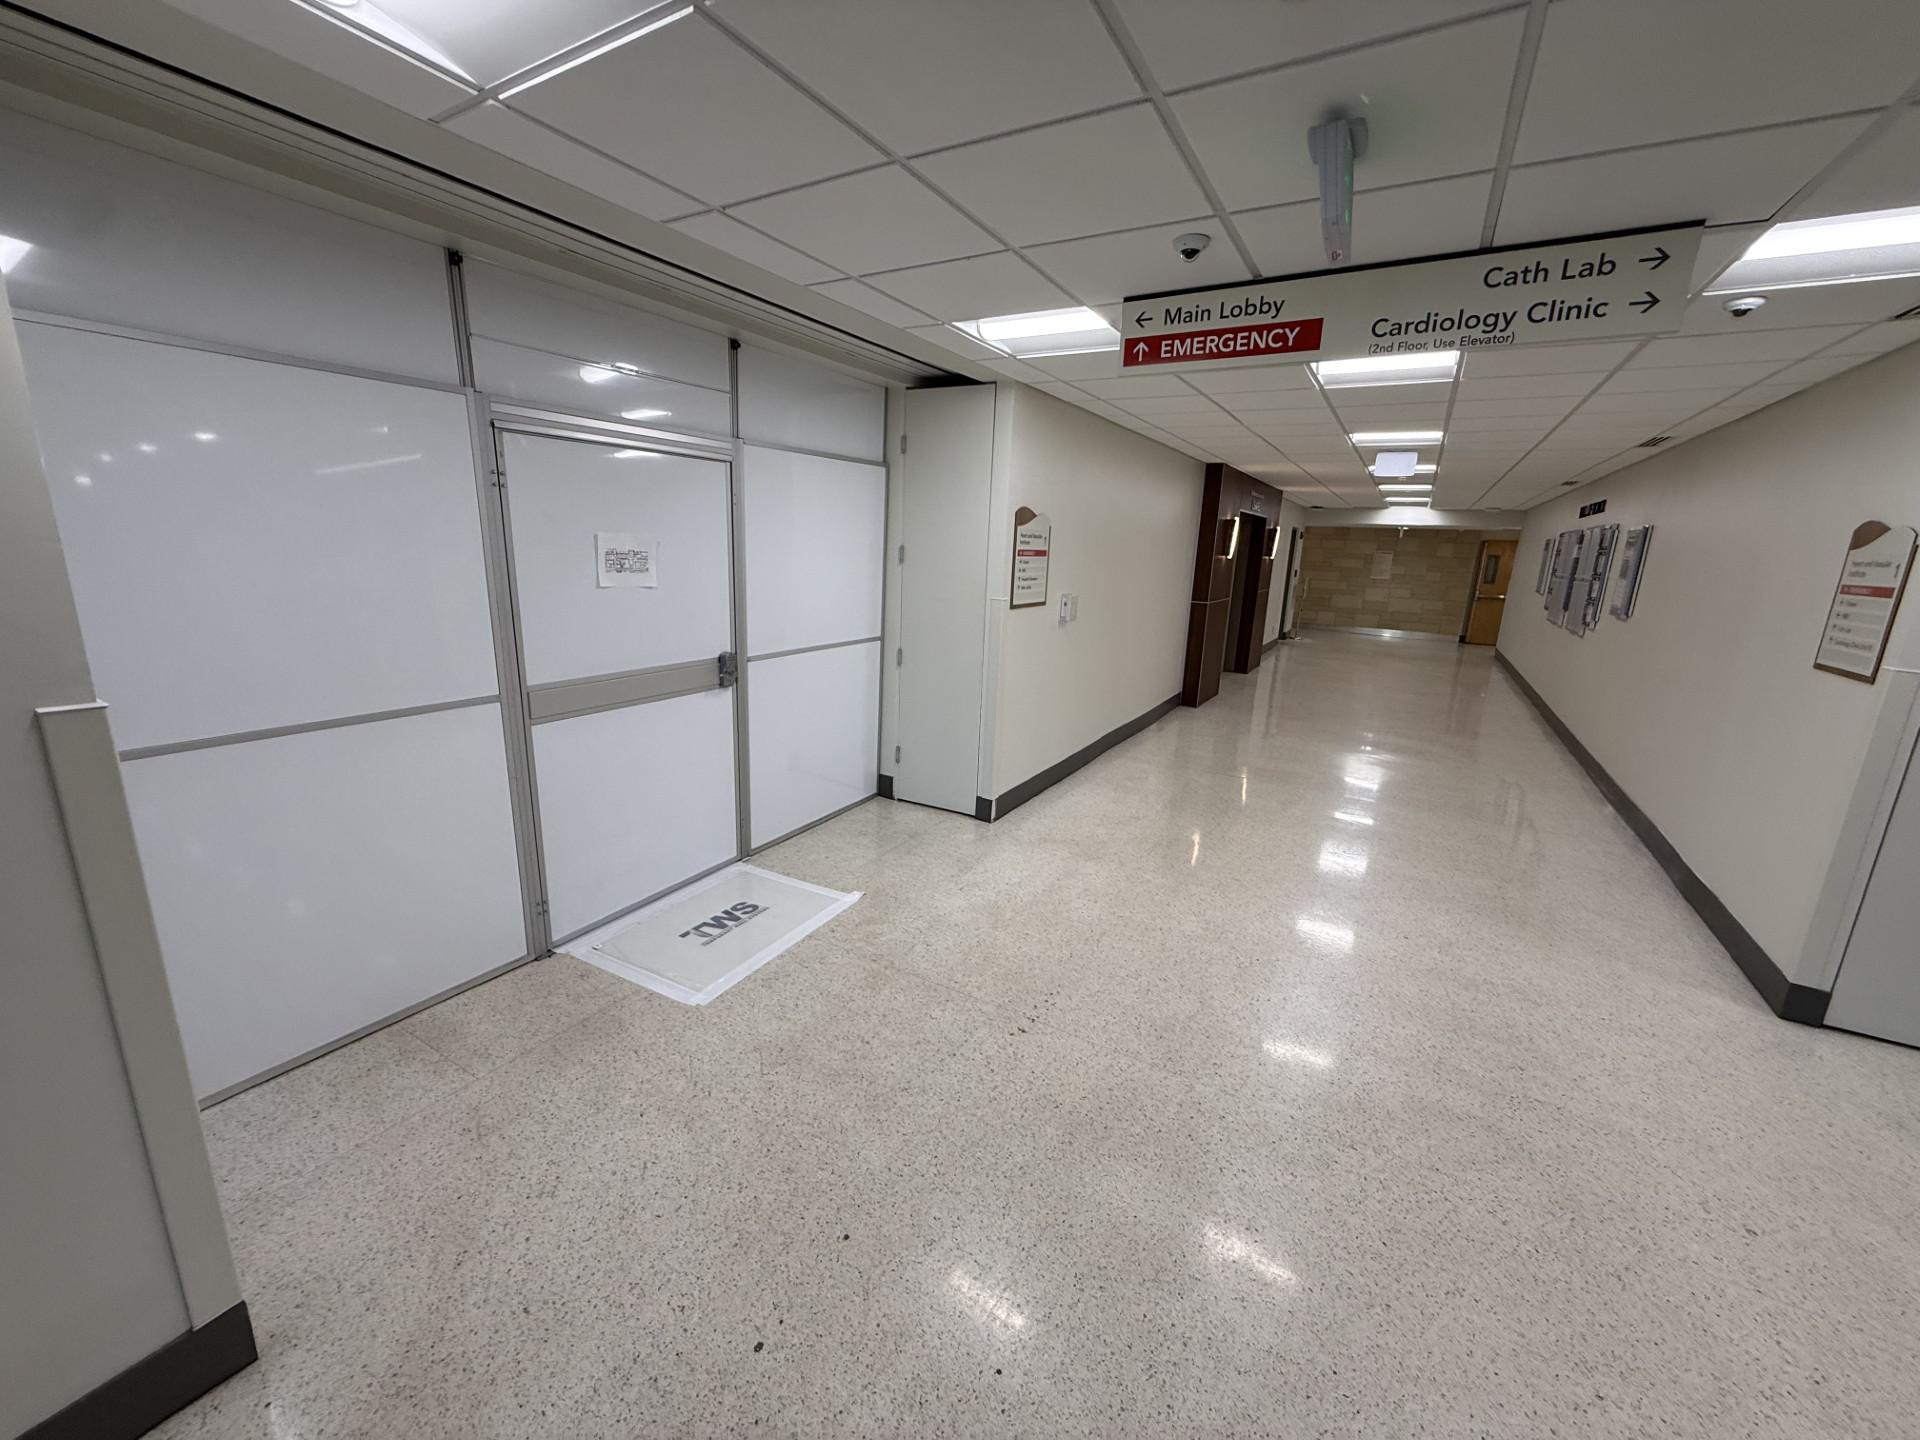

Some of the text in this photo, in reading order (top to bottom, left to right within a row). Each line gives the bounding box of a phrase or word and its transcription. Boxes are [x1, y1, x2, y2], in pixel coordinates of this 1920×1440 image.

[1483, 253, 1617, 288] Cath Lab
[1163, 296, 1286, 326] Main Lobby
[1371, 297, 1608, 338] Cardiology Clinic
[1160, 327, 1300, 358] EMERGENCY
[1368, 341, 1394, 356] (2nd
[1433, 337, 1455, 349] Use
[1459, 331, 1515, 347] Elevator)
[678, 901, 760, 938] TWS
